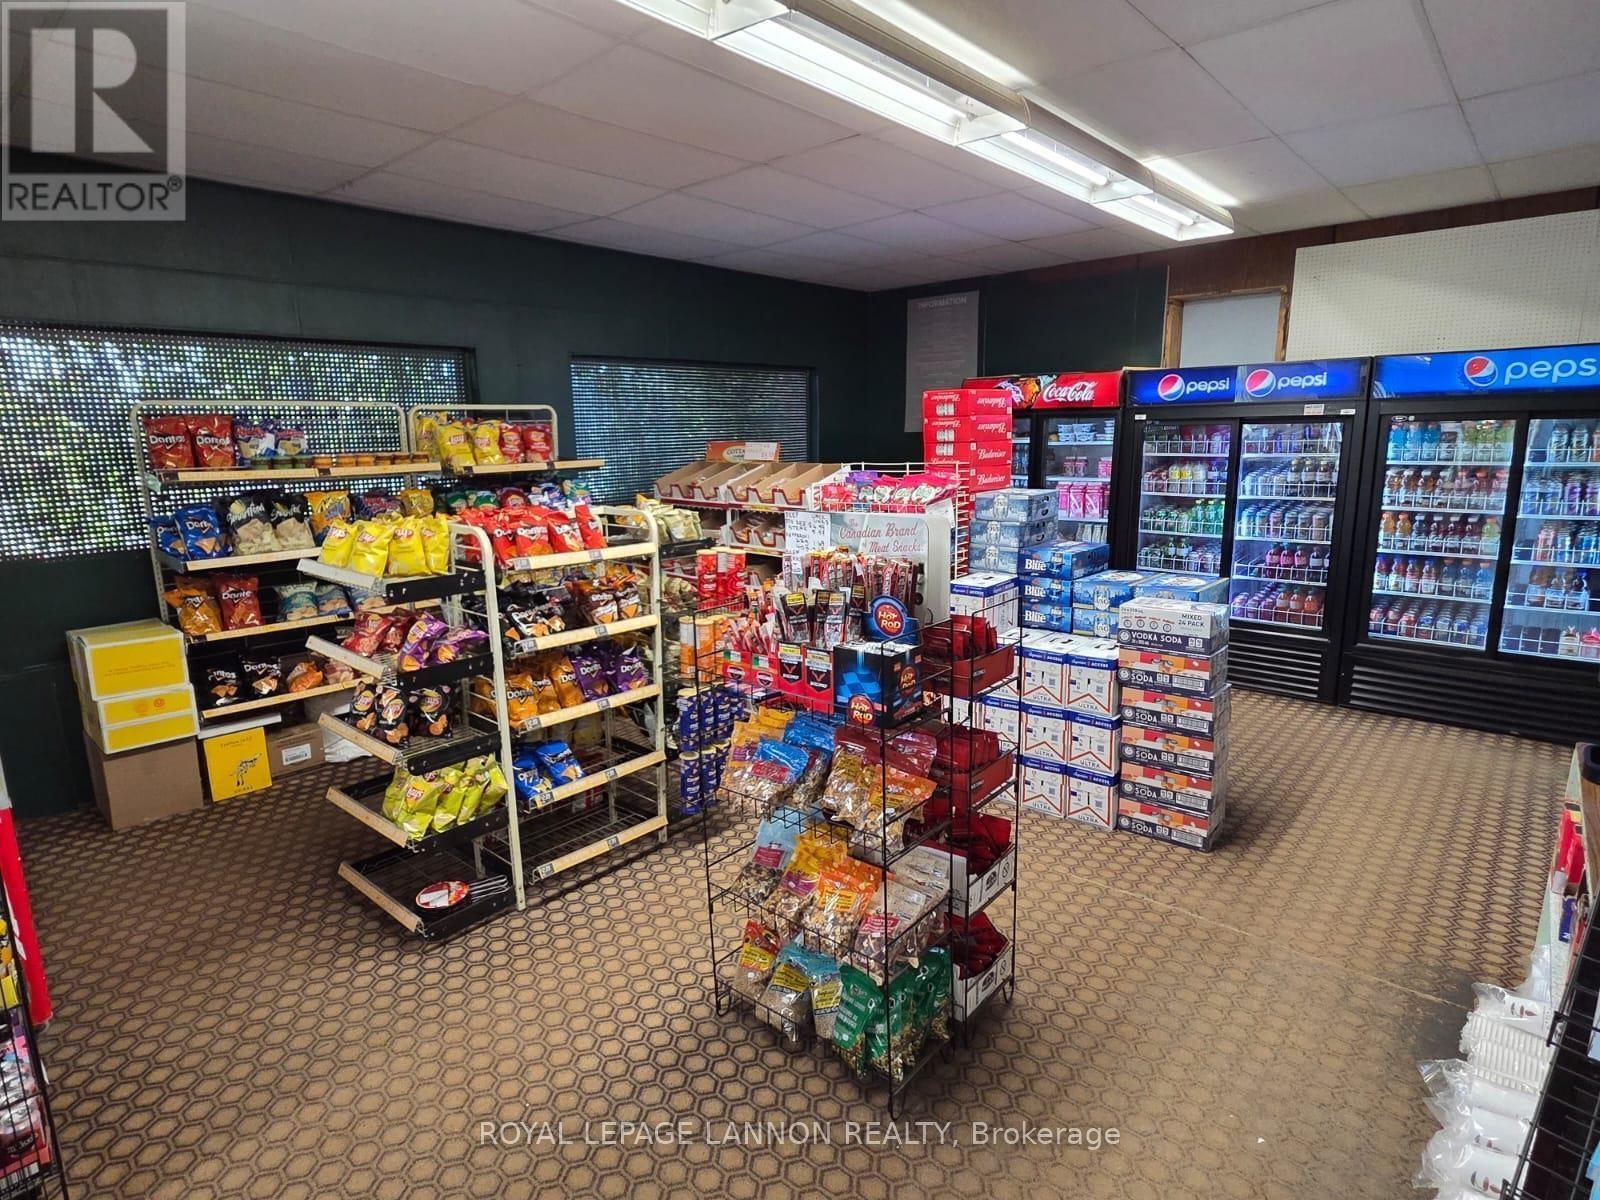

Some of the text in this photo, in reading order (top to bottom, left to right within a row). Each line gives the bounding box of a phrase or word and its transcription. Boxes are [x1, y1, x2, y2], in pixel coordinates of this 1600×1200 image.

[1503, 356, 1600, 386] peps
[1185, 377, 1230, 395] pepsi
[1277, 371, 1328, 390] pepsi
[1042, 381, 1098, 402] Coca-Cola
[976, 397, 1007, 408] Budweiser
[977, 422, 1007, 433] Budweiser
[149, 435, 186, 445] Doritos
[195, 435, 231, 446] Doritos
[977, 448, 1006, 460] Budweiser
[976, 474, 1006, 485] Budweiser
[839, 522, 919, 540] Canadian Brand
[869, 540, 891, 553] Meat
[891, 539, 922, 552] Snacks
[1024, 558, 1047, 571] Blue
[1024, 584, 1047, 597] Blue
[878, 610, 898, 620] HOT
[1024, 610, 1047, 623] Blue
[1182, 613, 1203, 621] MIXED
[880, 619, 901, 629] ROD
[1187, 620, 1205, 628] PACK
[1131, 631, 1158, 642] VODKA
[1160, 635, 1183, 645] SODA
[1131, 673, 1154, 683] SODA
[1033, 694, 1051, 702] ULTRA
[1080, 703, 1099, 711] ULTRA
[1135, 712, 1158, 723] SODA
[1034, 749, 1054, 758] ULTRA
[1135, 750, 1158, 762] SODA
[1080, 759, 1100, 768] ULTRA
[1134, 787, 1157, 798] SODA
[1032, 801, 1051, 810] ULTRA
[1131, 822, 1153, 834] SODA
